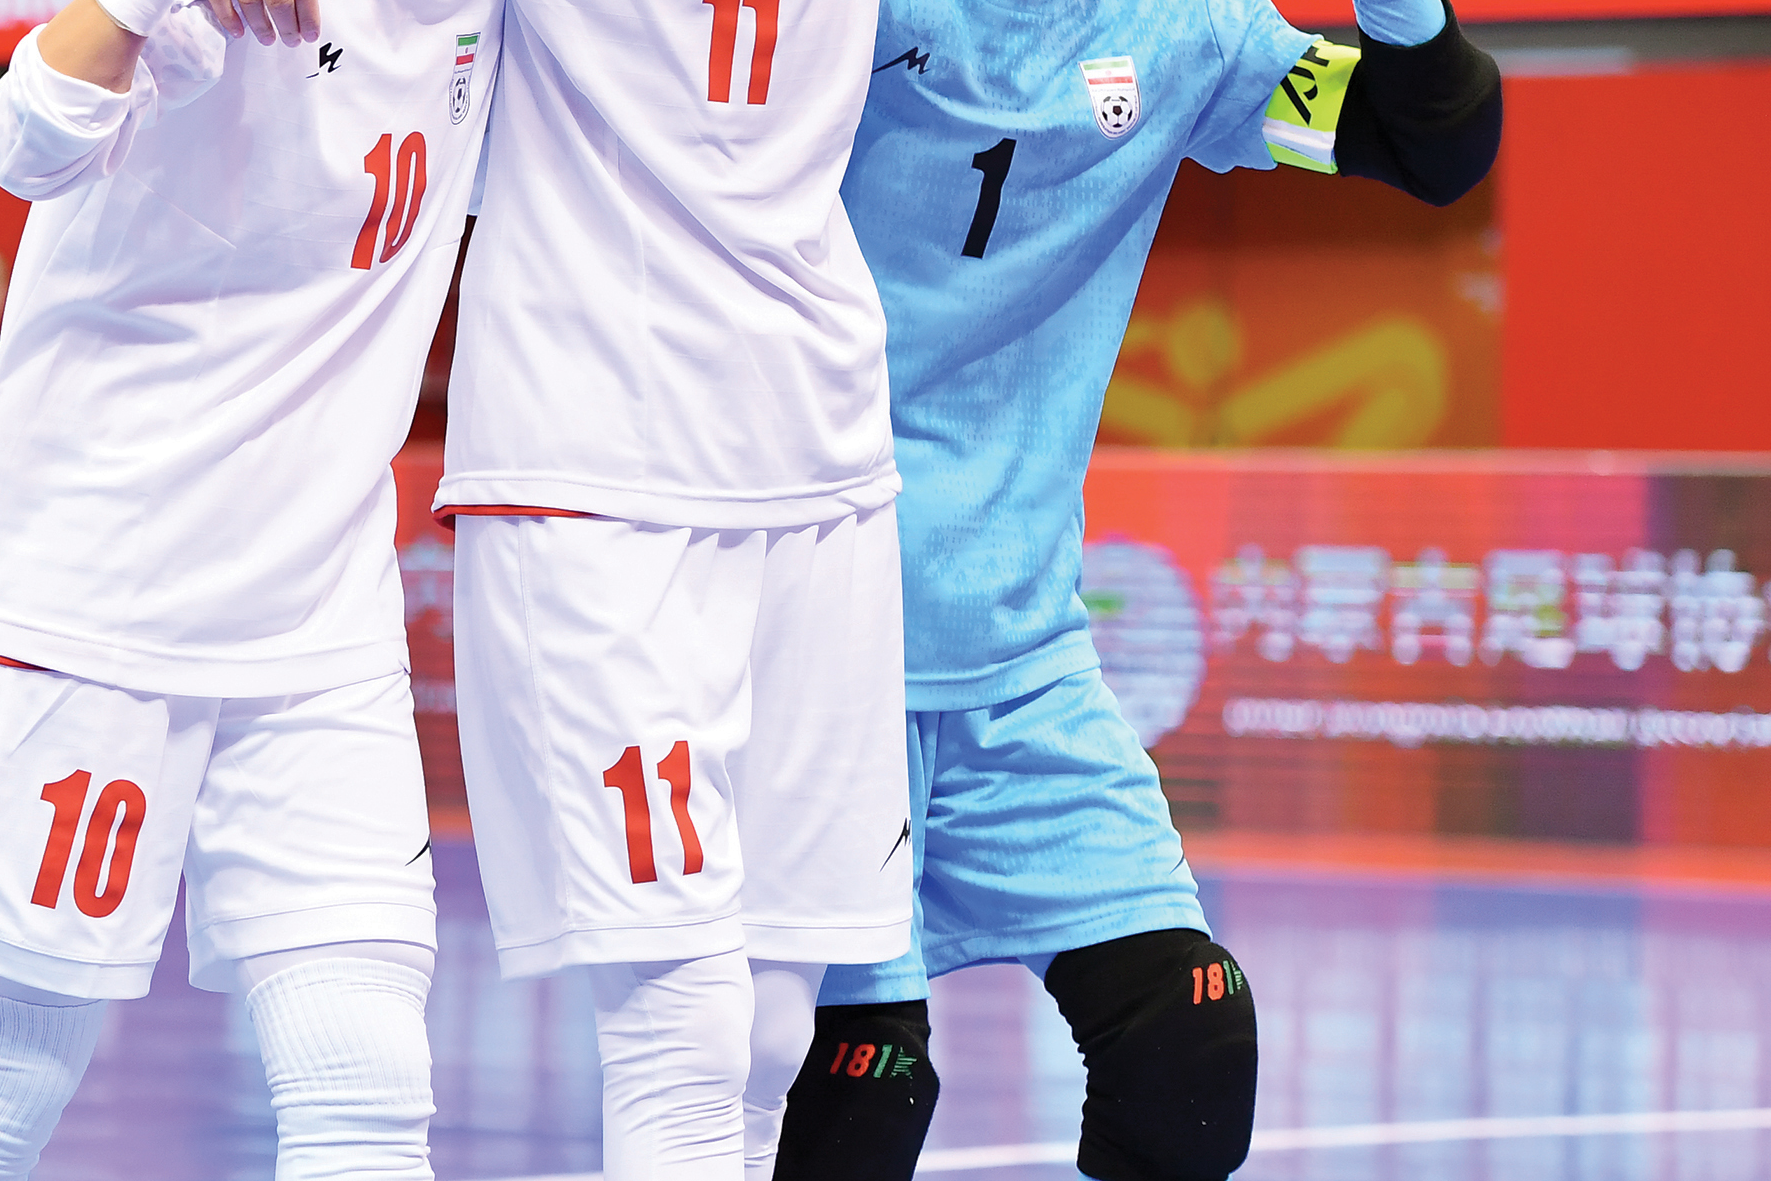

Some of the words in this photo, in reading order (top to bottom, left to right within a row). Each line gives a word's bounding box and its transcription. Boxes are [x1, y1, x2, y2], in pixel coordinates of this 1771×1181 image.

[350, 131, 427, 270] 10
[961, 137, 1017, 259] 1
[31, 769, 147, 918] 10
[602, 740, 704, 884] 11
